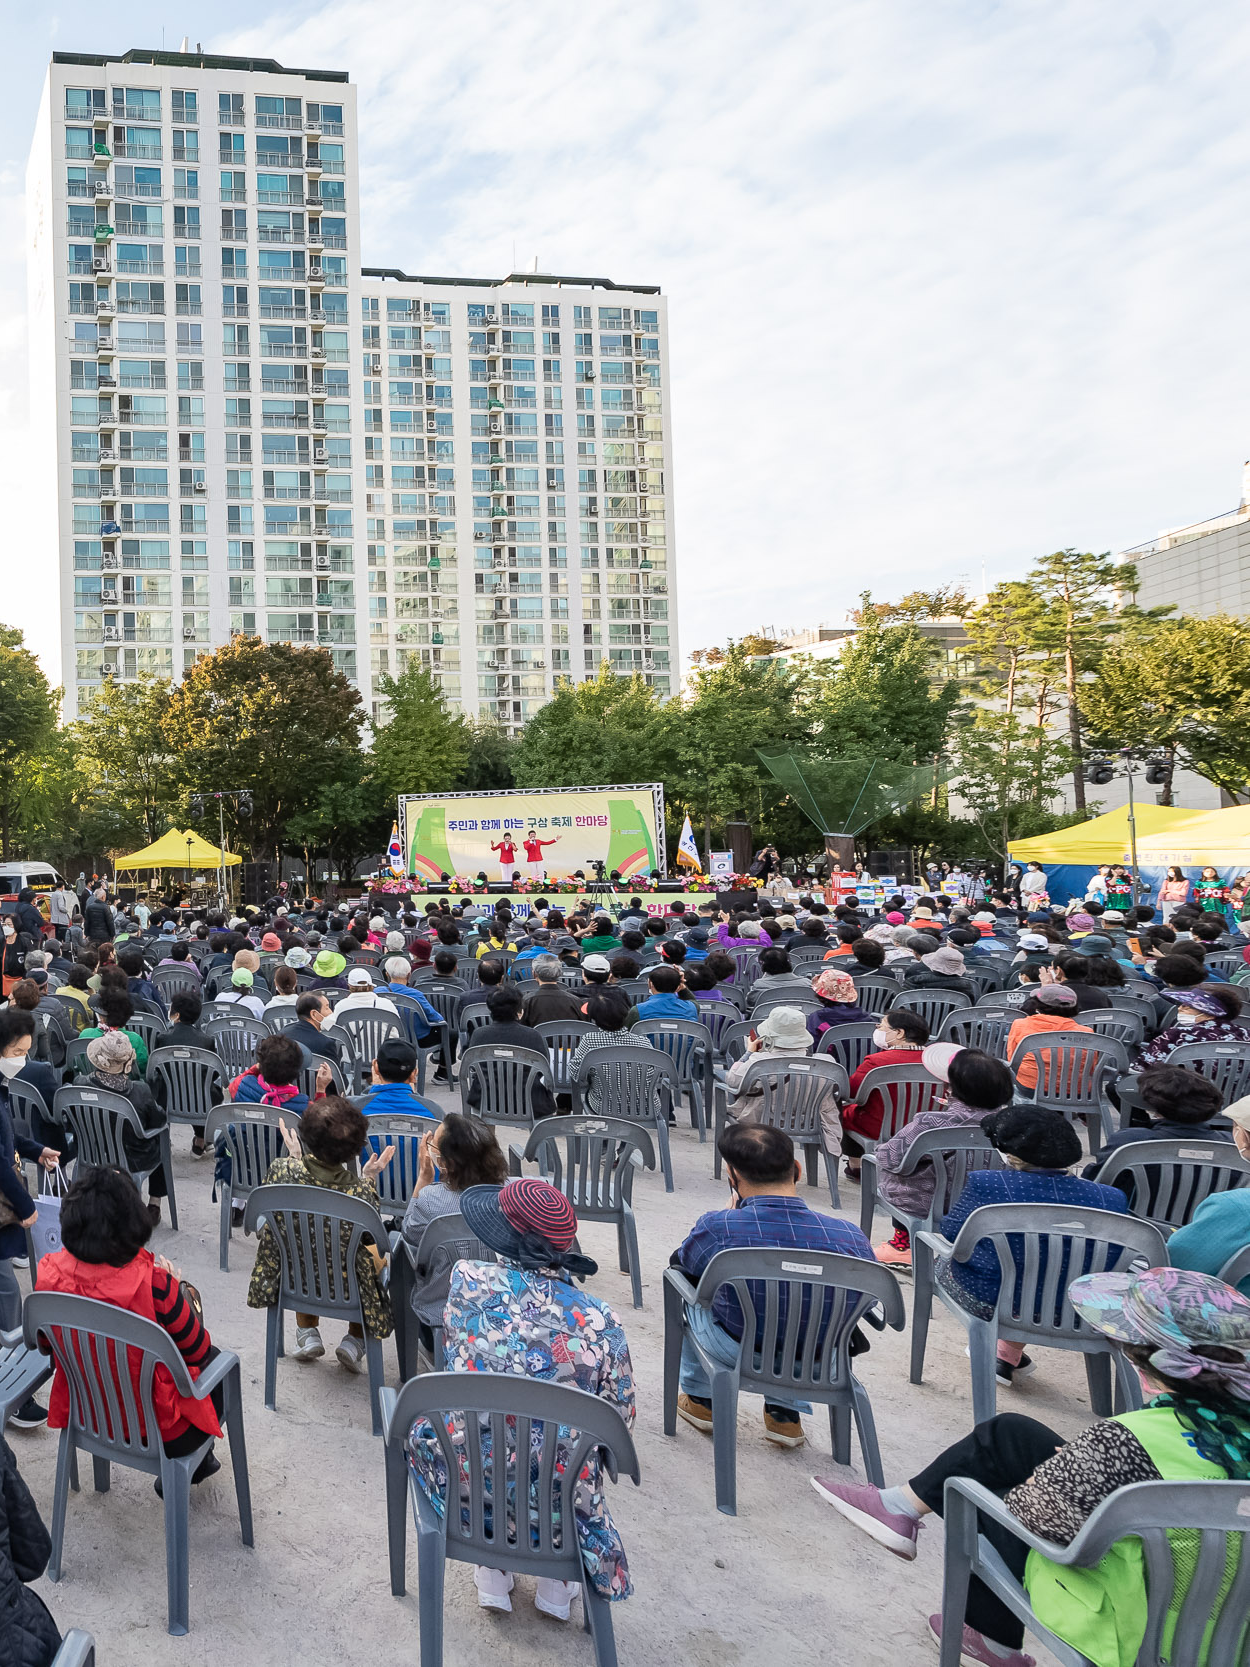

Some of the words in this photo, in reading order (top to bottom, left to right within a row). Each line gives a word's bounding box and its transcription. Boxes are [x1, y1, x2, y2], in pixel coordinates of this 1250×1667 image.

[448, 820, 478, 831] 주민과
[480, 819, 501, 830] 함께
[503, 818, 524, 829] 하는
[551, 816, 572, 827] 축제
[575, 815, 608, 826] 한마당
